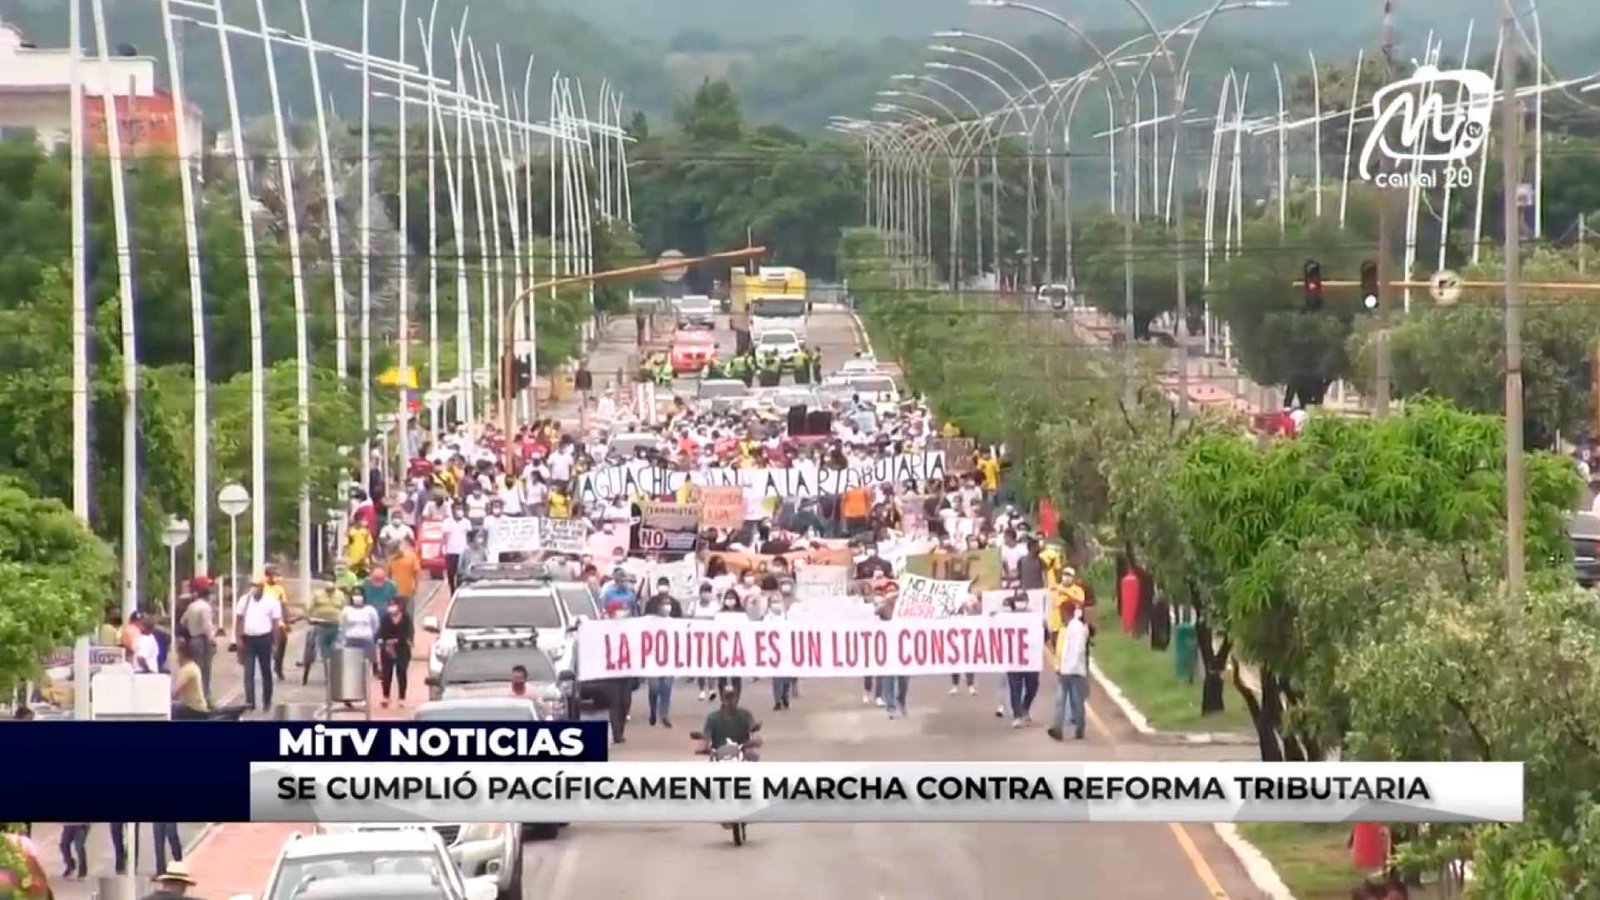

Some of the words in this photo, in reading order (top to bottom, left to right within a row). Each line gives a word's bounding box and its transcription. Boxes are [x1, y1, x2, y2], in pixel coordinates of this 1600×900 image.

[580, 465, 692, 500] AGUACHIC
[641, 530, 664, 546] NO
[604, 633, 632, 671] LA
[640, 624, 746, 668] POLÍTICA
[754, 631, 781, 667] ES
[791, 631, 822, 668] UN
[832, 630, 887, 667] LUTO
[898, 627, 1029, 666] CONSTANTE
